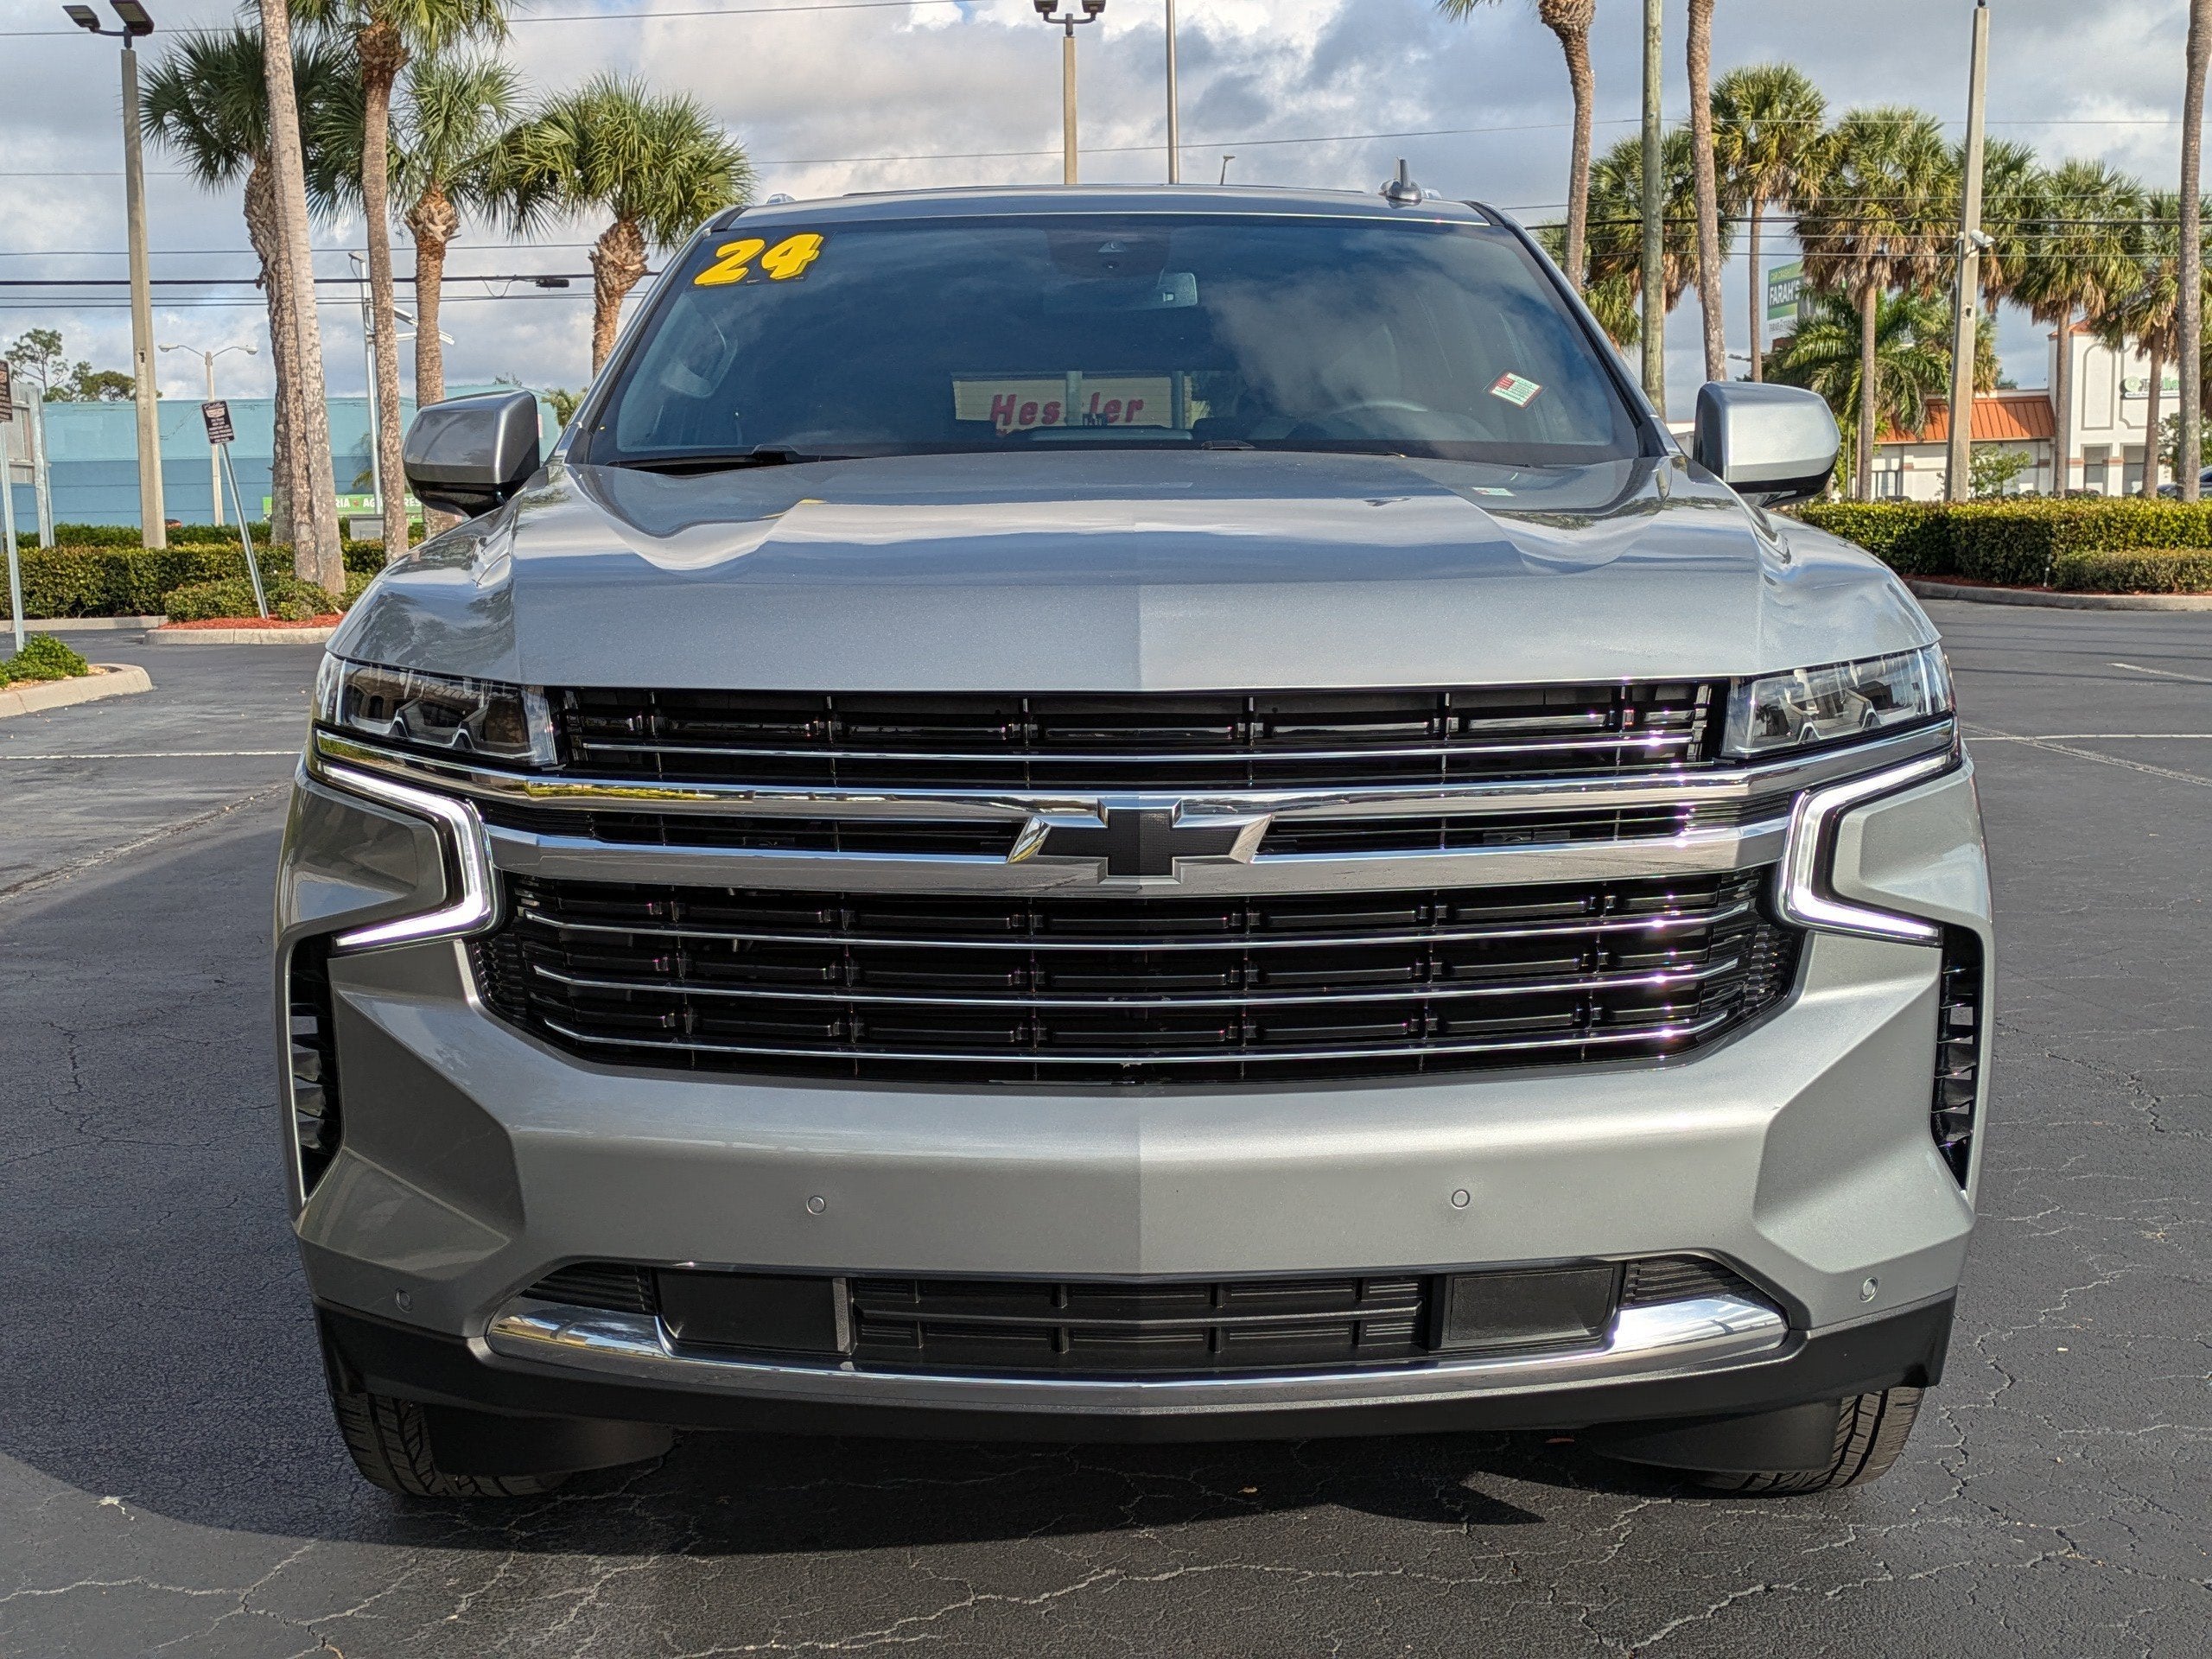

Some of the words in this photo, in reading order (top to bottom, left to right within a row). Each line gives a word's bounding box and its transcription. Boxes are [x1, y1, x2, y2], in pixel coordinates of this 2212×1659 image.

[694, 233, 824, 286] 24
[1769, 279, 1801, 306] FARAH'S
[989, 391, 1145, 426] Hesler
